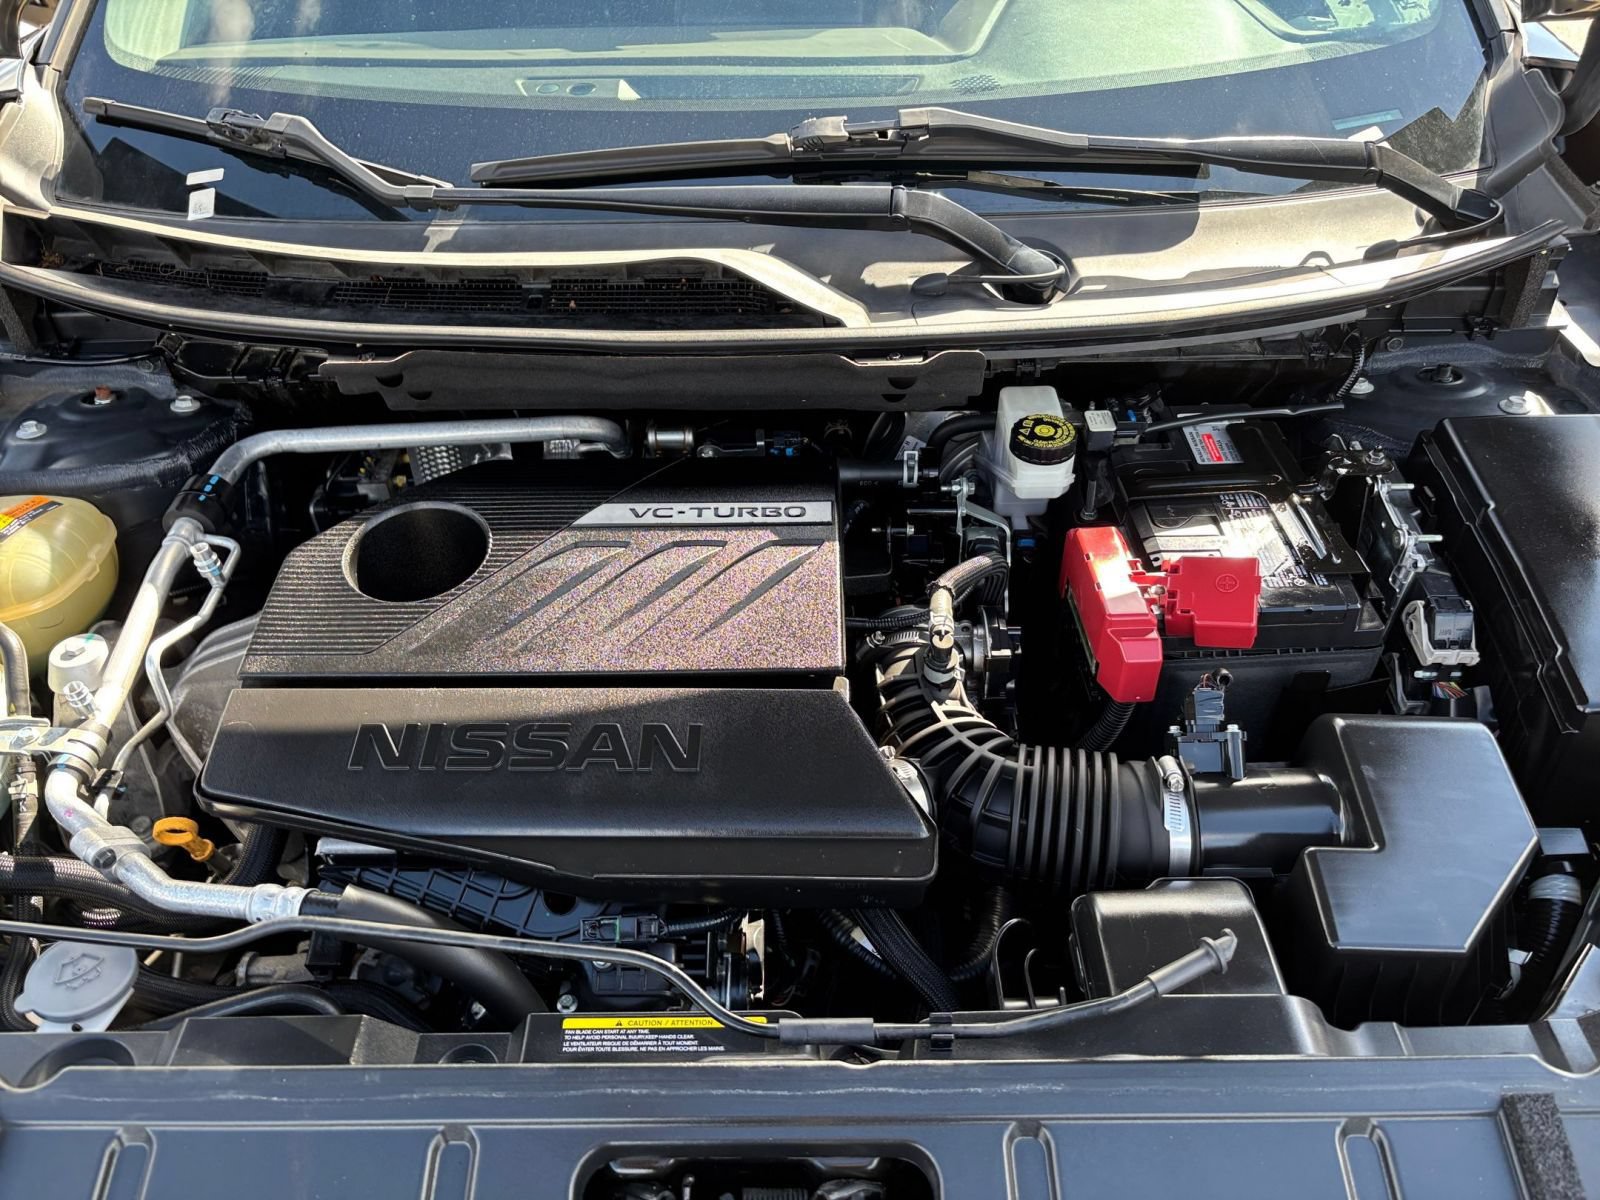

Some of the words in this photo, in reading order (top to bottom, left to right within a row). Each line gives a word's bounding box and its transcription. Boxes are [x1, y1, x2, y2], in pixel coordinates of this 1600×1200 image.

[628, 505, 808, 519] VC-TURBO
[347, 721, 704, 773] NISSAN
[627, 1019, 663, 1027] CAUTION
[671, 1018, 713, 1026] ATTENTION
